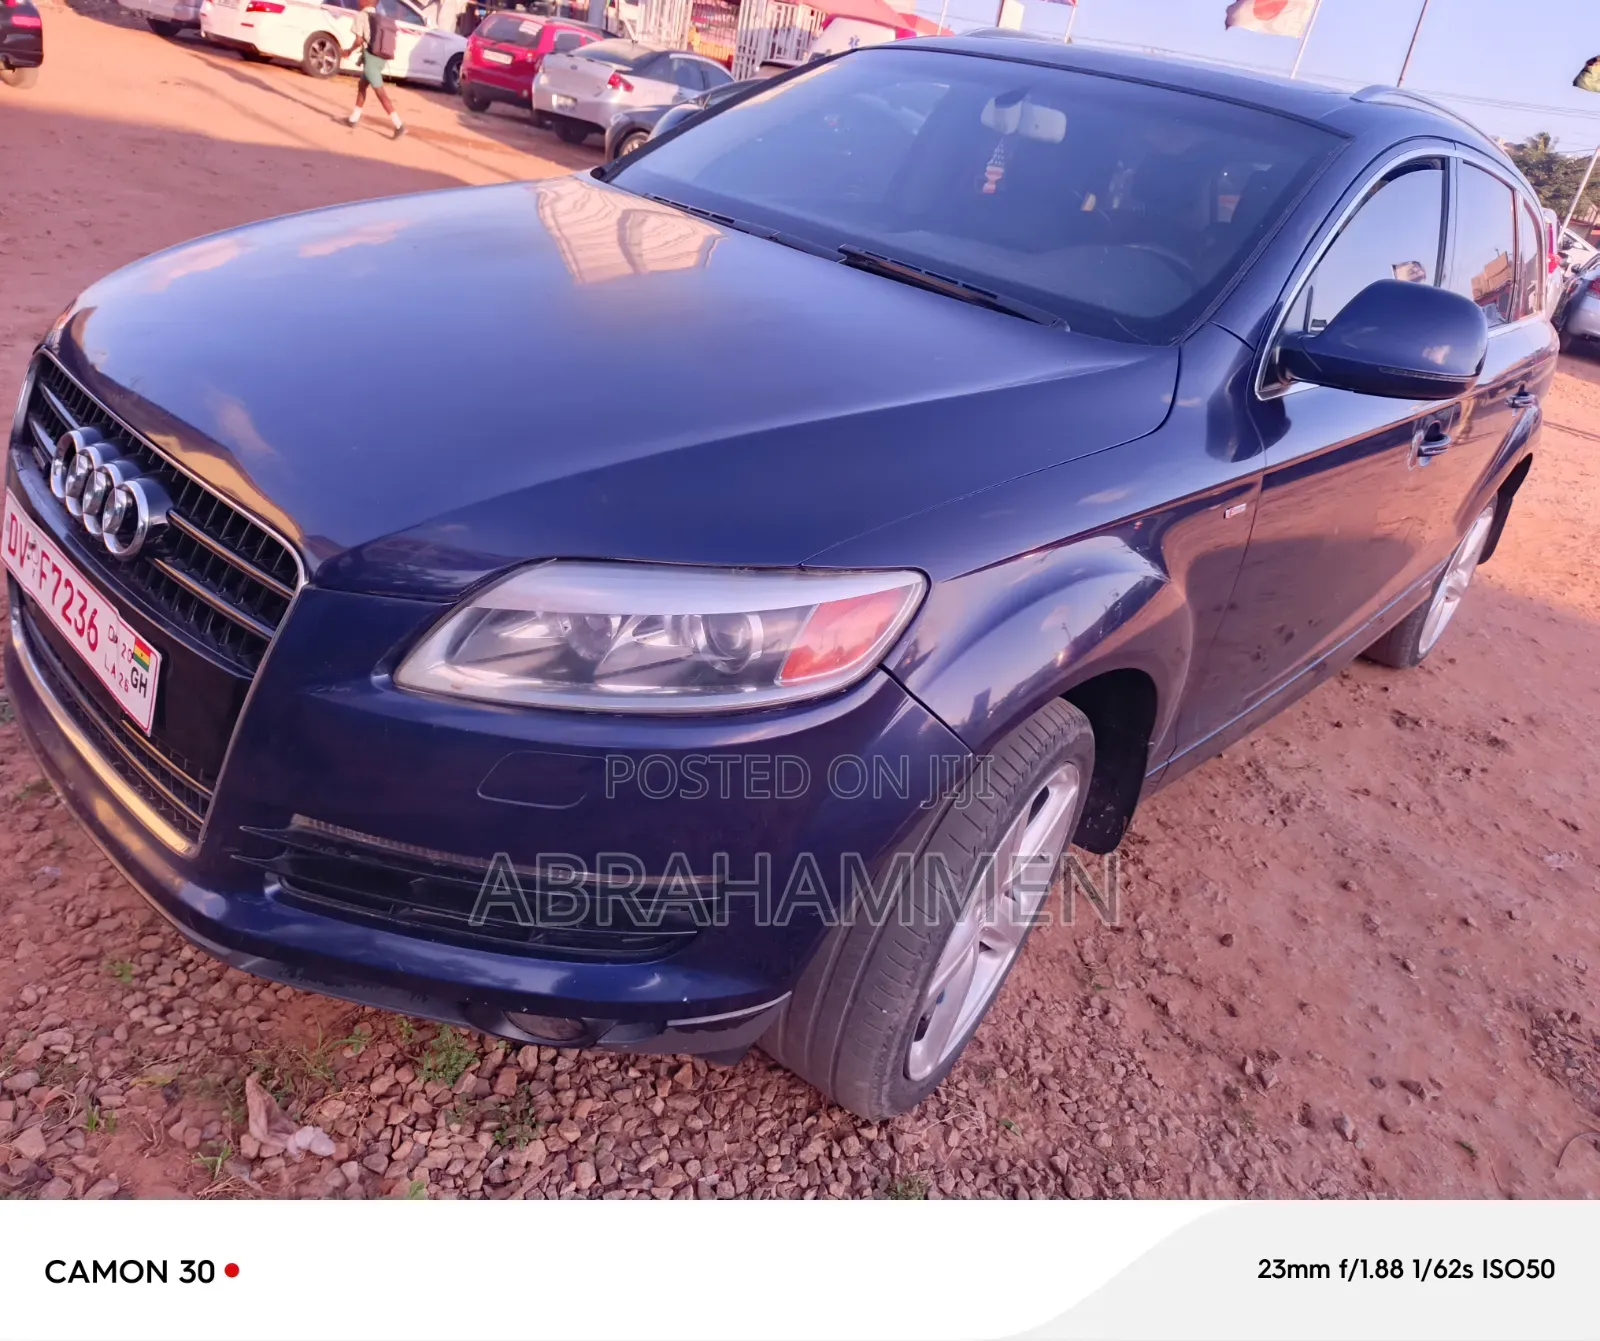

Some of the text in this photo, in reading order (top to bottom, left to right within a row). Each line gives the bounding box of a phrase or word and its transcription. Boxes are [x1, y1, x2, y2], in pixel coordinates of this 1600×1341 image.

[8, 512, 98, 652] DV F7236
[131, 666, 148, 698] GH
